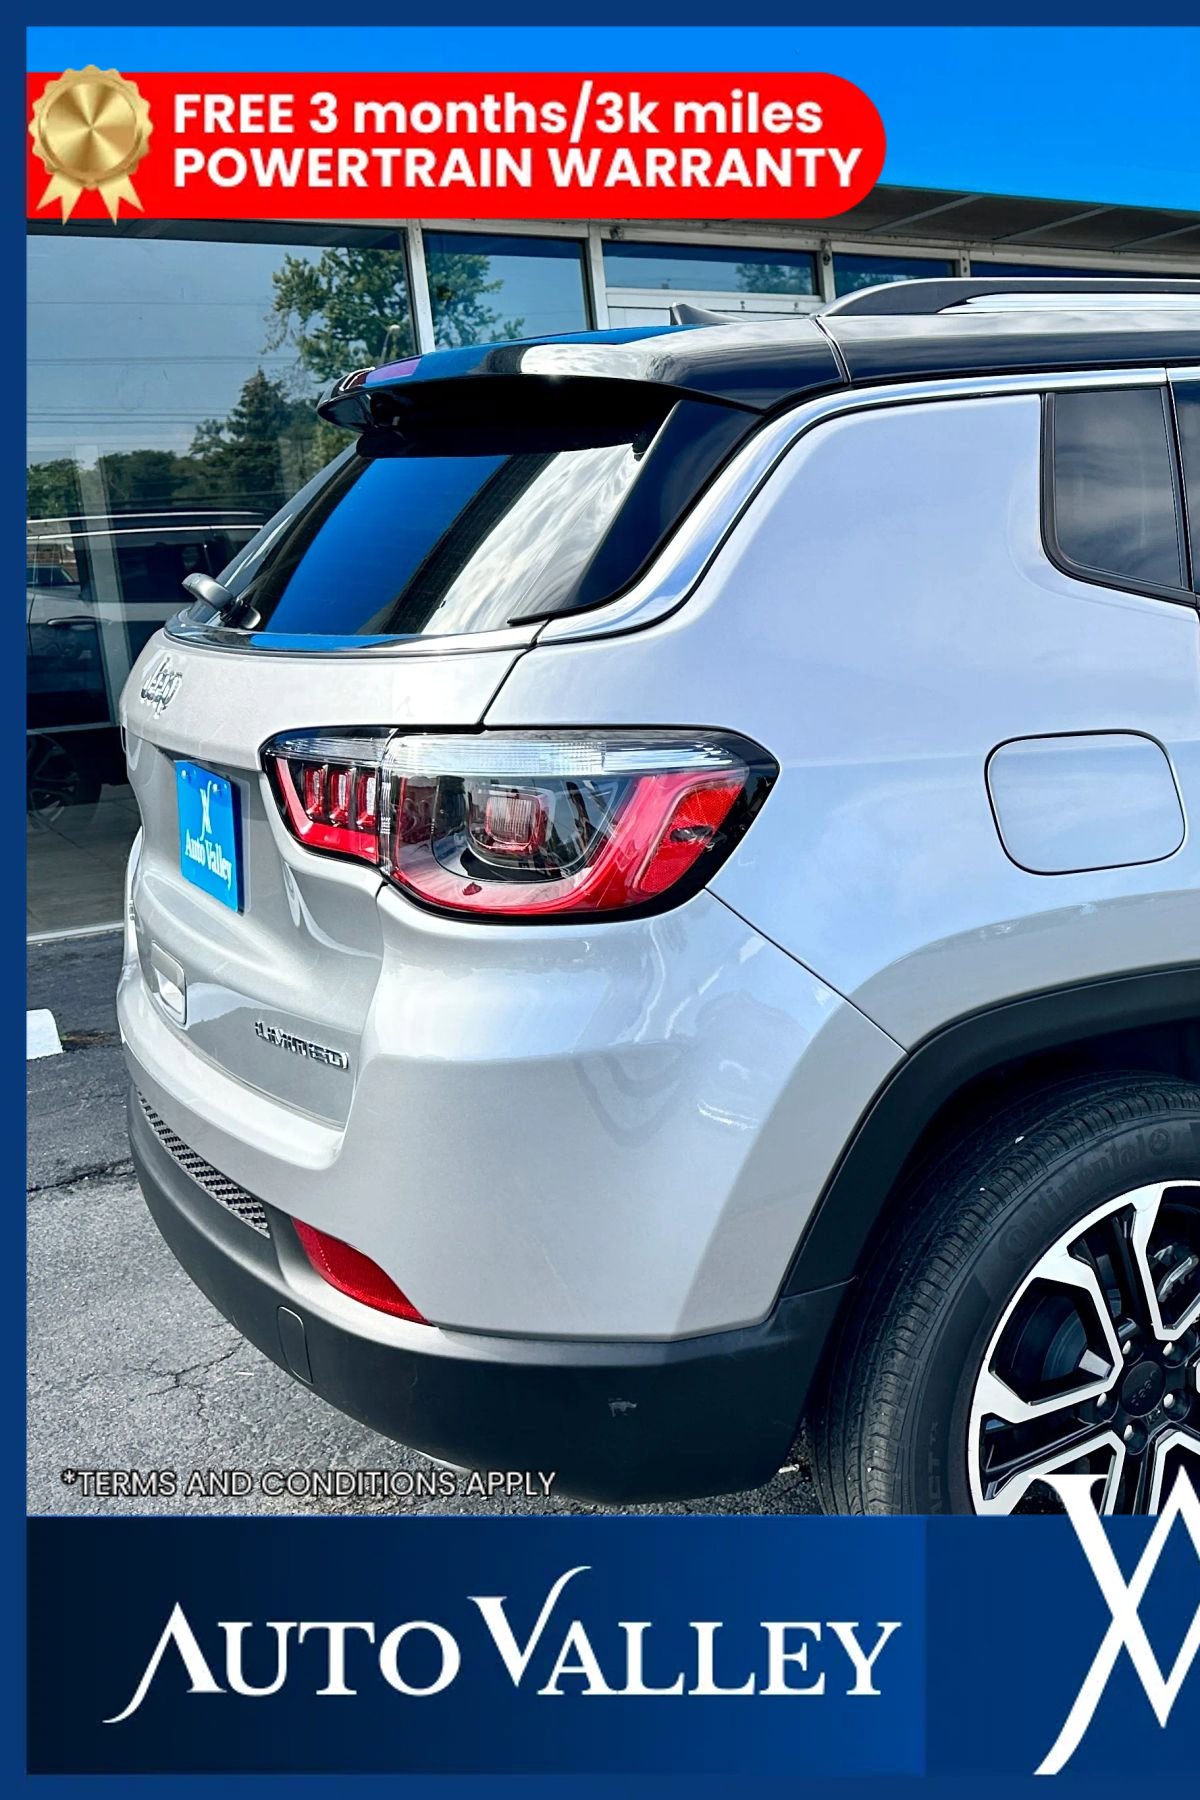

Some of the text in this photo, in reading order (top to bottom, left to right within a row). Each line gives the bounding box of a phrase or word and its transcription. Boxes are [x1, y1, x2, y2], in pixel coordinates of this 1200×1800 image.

[141, 656, 183, 719] Jeep
[185, 828, 232, 891] Auto Valley
[255, 1019, 350, 1070] LIMITED
